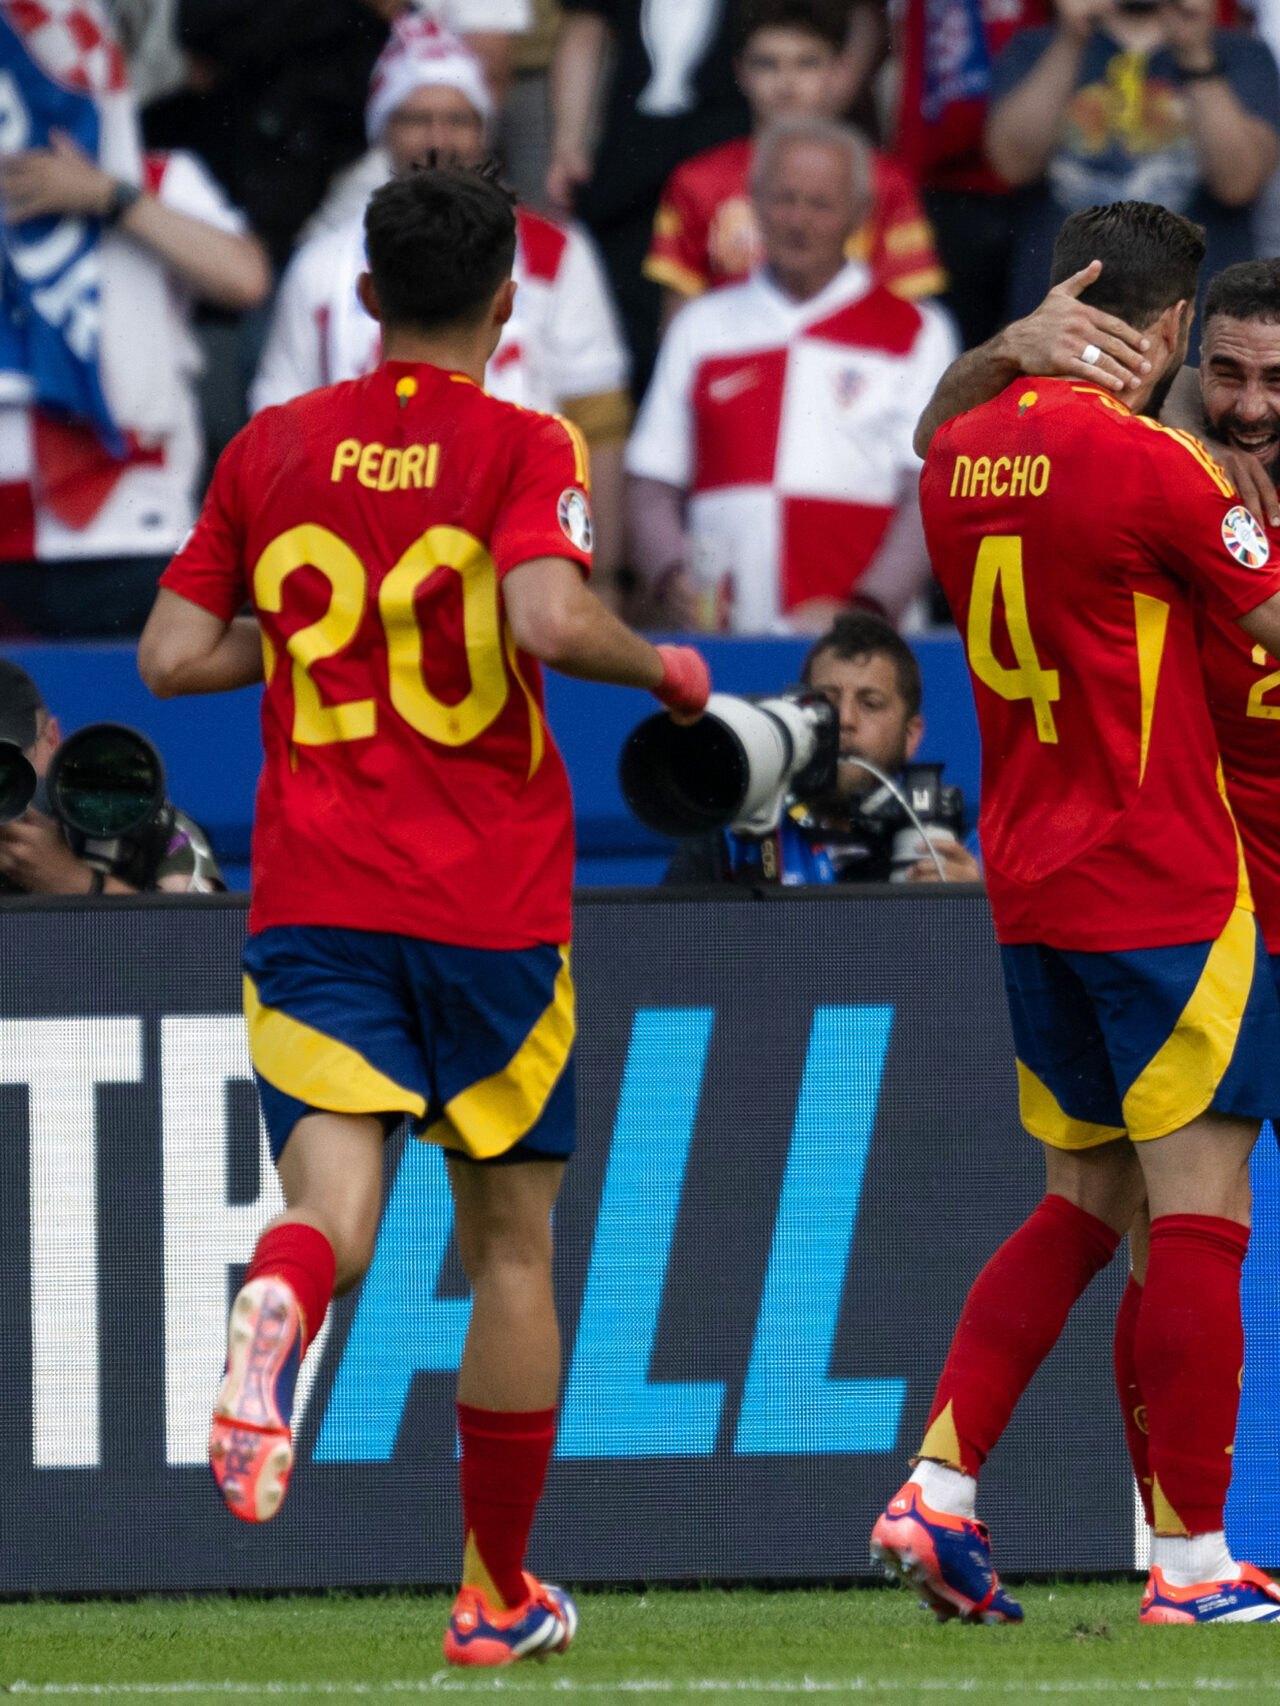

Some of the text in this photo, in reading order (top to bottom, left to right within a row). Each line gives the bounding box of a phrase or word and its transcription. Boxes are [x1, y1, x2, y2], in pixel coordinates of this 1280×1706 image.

[331, 439, 439, 491] PEDRI
[950, 454, 1051, 497] NACHO
[253, 523, 508, 747] 20
[967, 535, 1060, 744] 4
